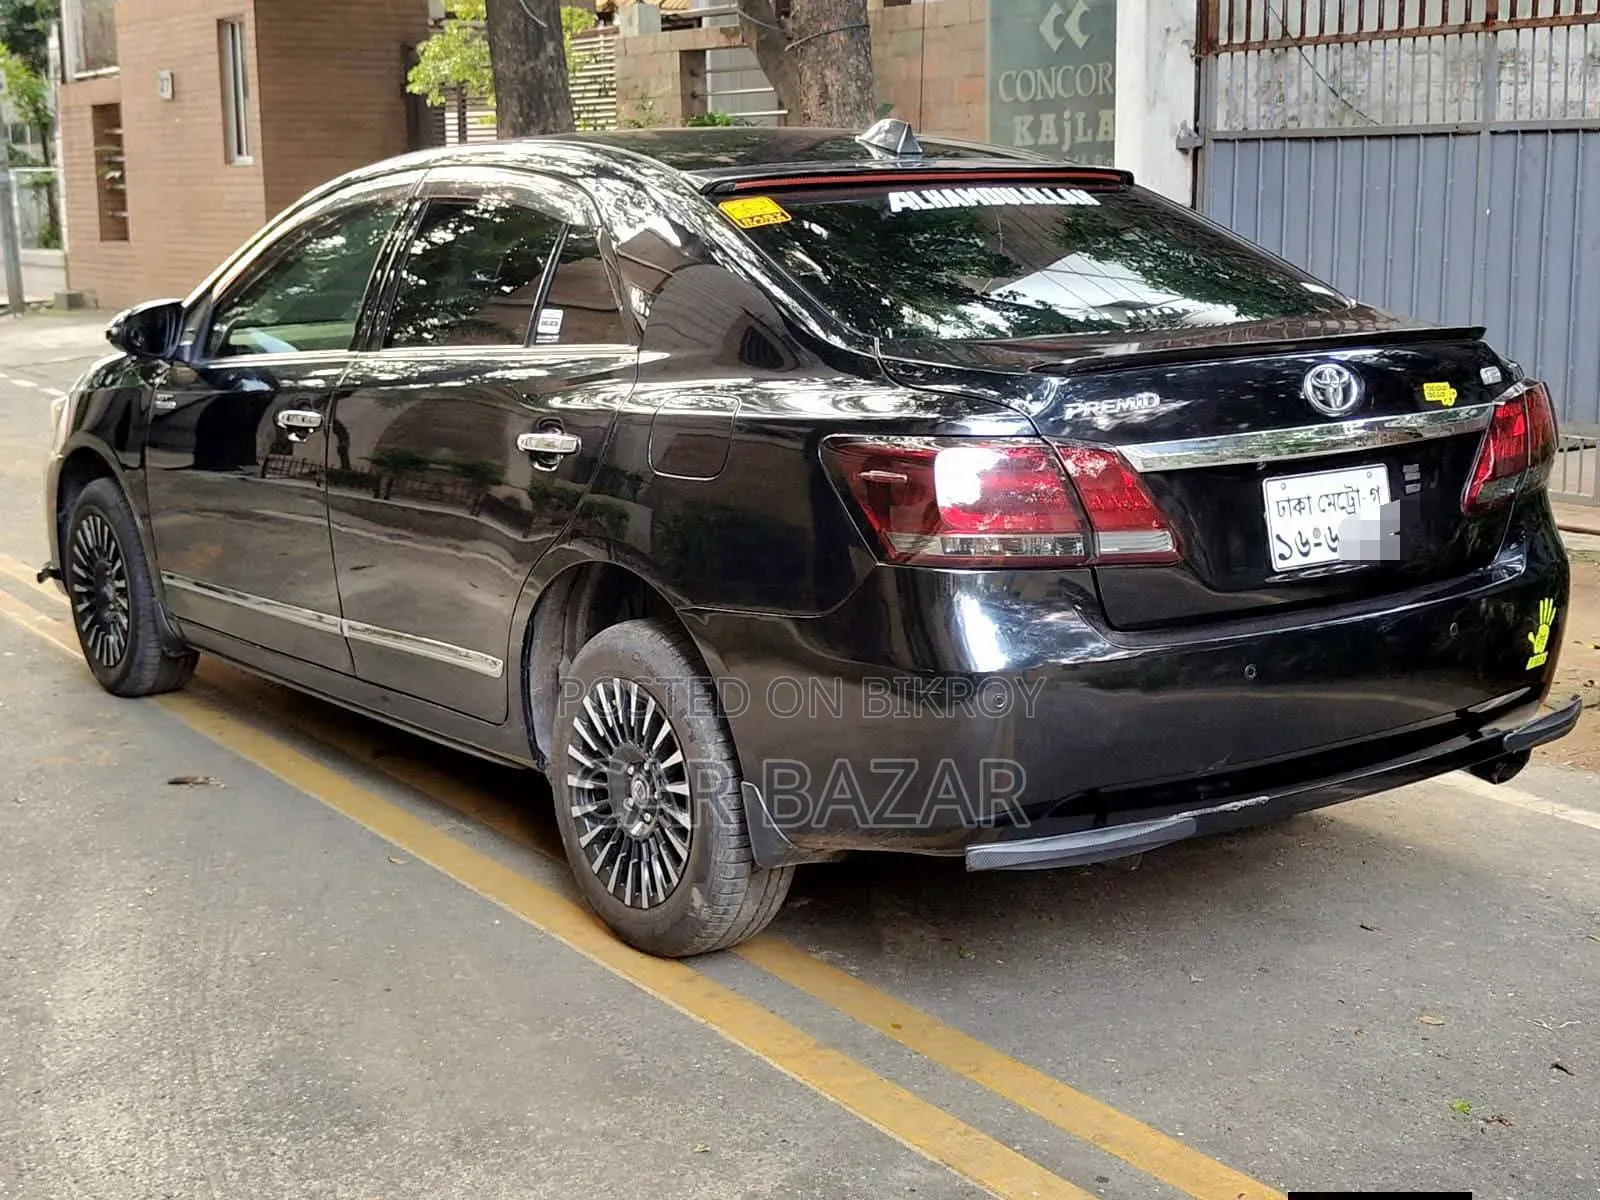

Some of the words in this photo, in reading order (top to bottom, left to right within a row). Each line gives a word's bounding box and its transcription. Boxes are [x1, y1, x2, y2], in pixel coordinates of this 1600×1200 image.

[999, 62, 1114, 102] CONCOR
[1063, 392, 1160, 420] PREMIO
[1275, 495, 1313, 518] ঢাকা
[1275, 526, 1340, 561] ১৬-৬
